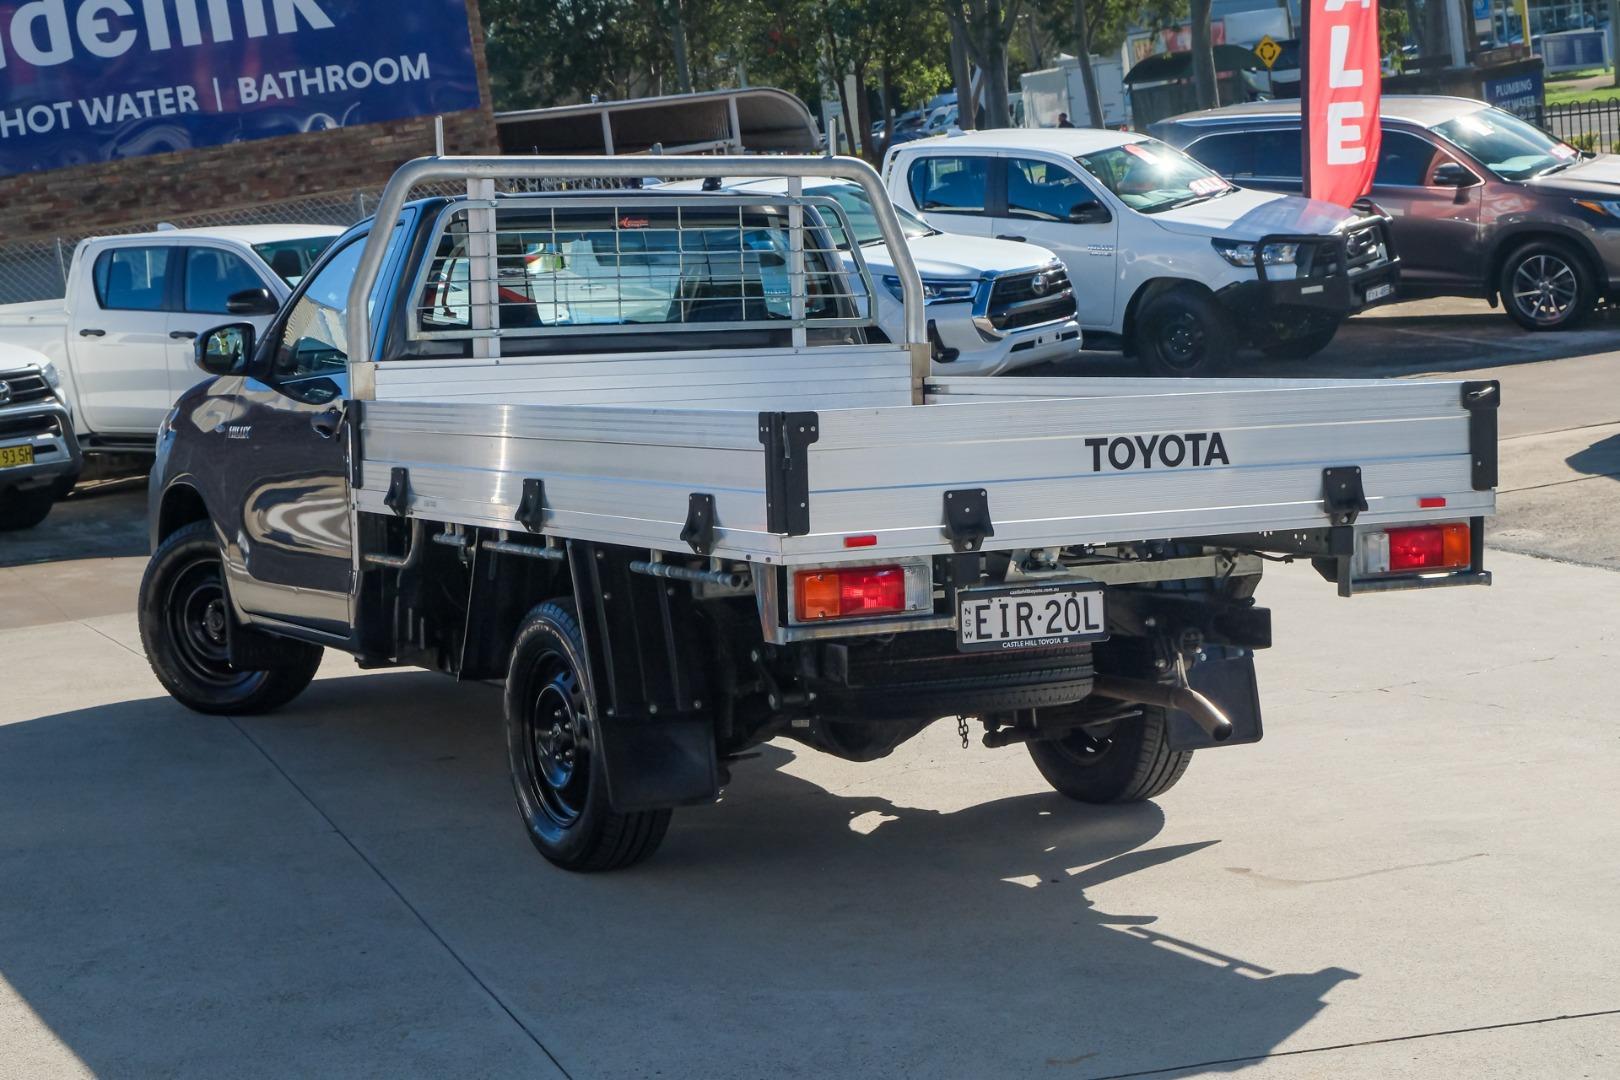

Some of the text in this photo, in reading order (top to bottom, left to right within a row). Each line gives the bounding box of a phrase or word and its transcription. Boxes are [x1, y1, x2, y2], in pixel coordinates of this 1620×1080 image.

[0, 52, 431, 138] HOT WATER BATHROOM
[1324, 0, 1370, 165] LE
[1495, 78, 1533, 97] PLUMBING
[1084, 432, 1230, 472] TOYOTA
[964, 607, 973, 640] NSW
[1002, 640, 1024, 649] CASTLE
[1038, 637, 1062, 645] TOYOTA
